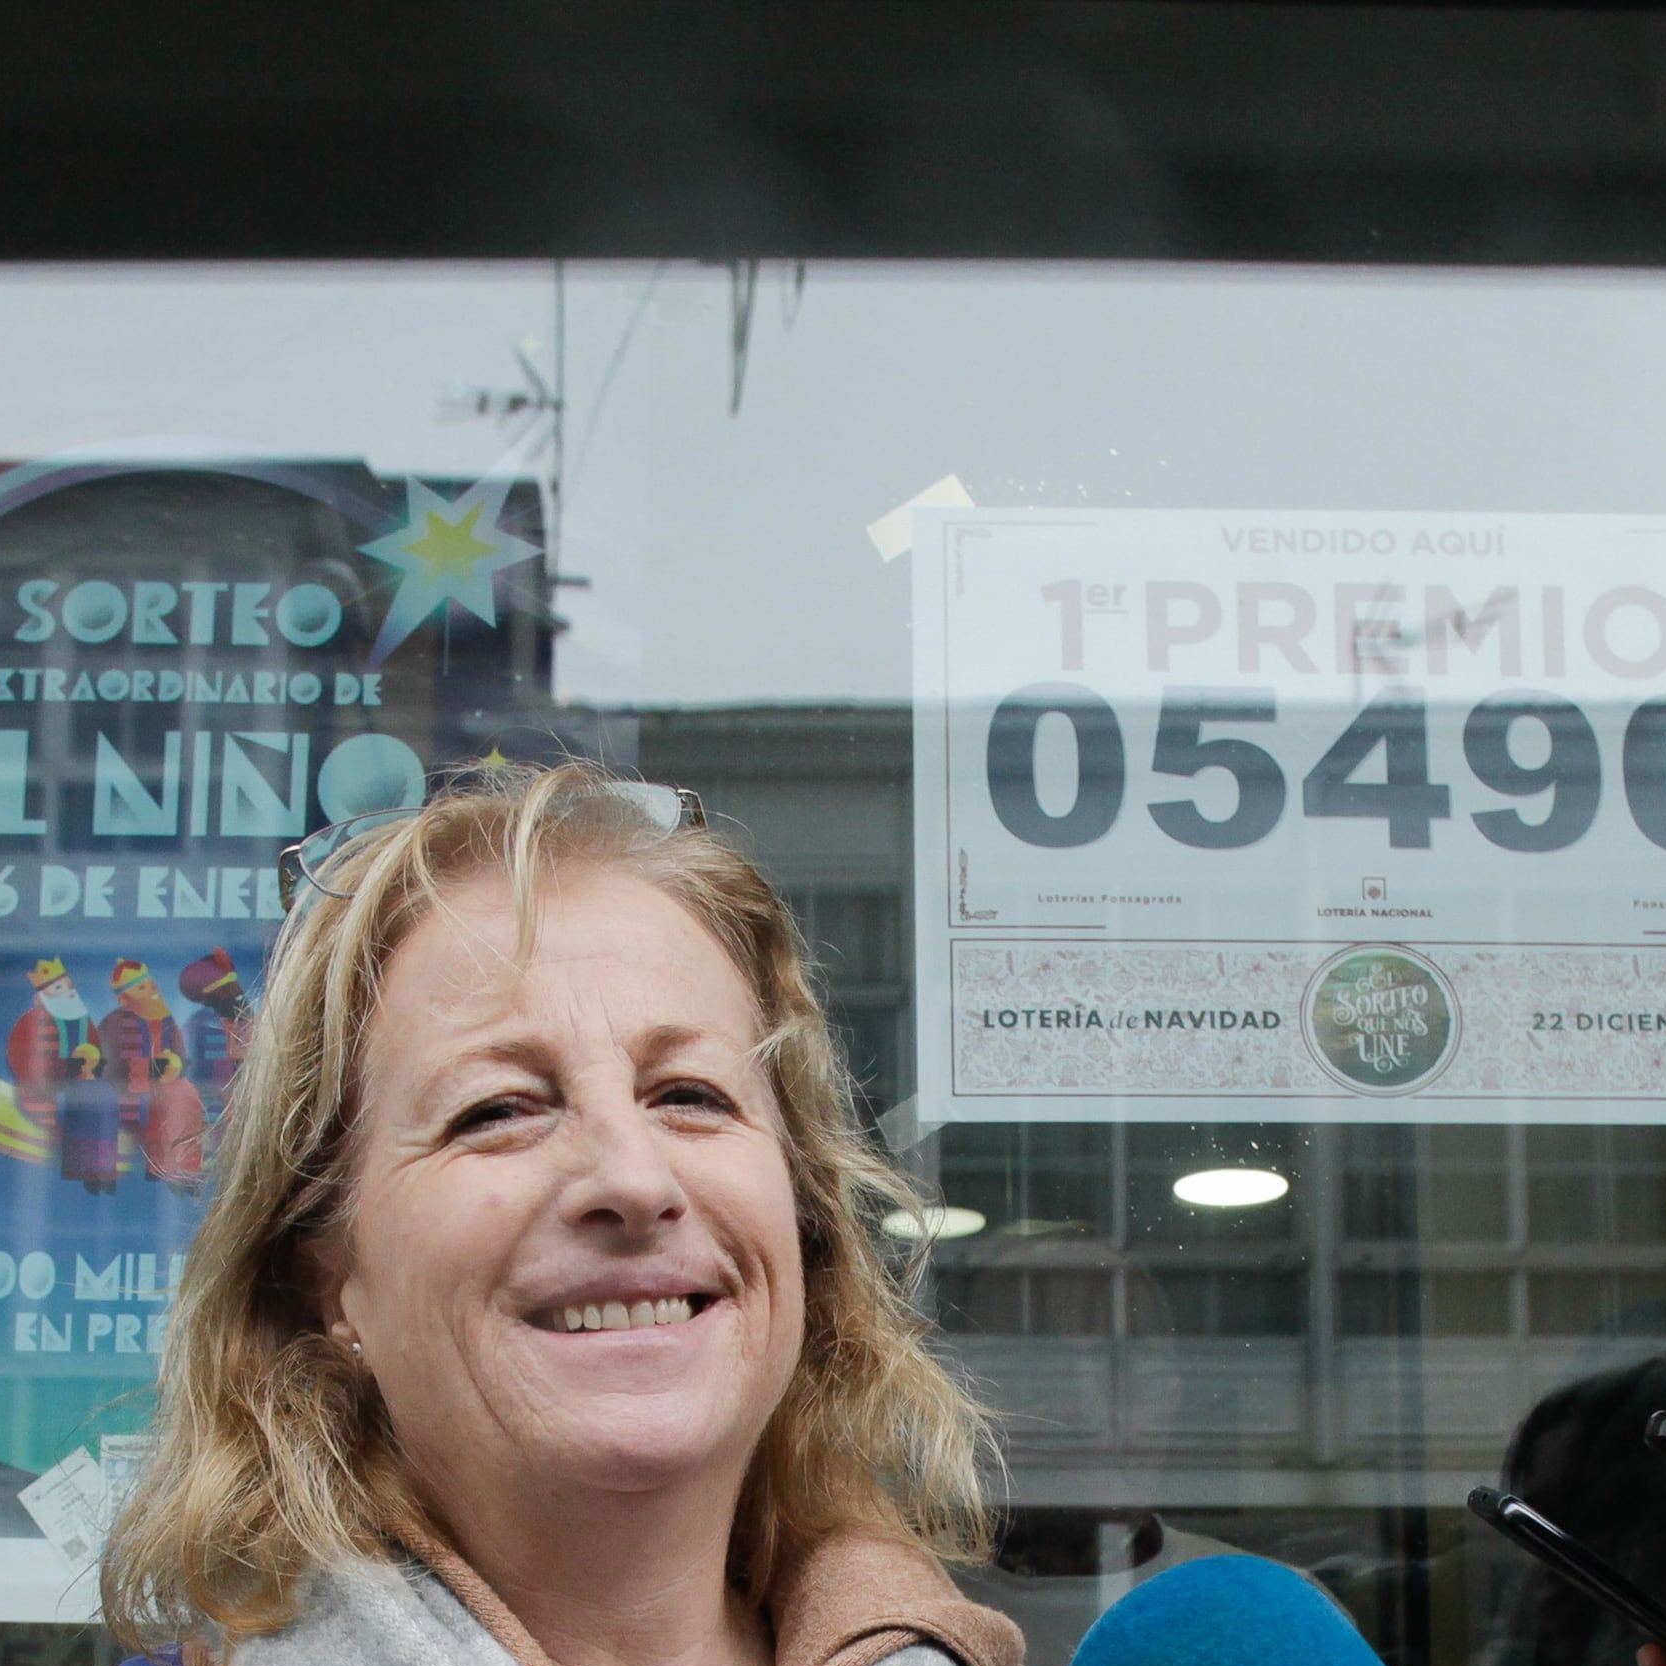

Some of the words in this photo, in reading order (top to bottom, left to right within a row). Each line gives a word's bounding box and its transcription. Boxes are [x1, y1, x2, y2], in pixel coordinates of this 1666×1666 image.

[1221, 525, 1399, 557] VENDIDO
[1409, 520, 1506, 559] AQUÍ
[13, 579, 343, 648] SORTEO
[334, 672, 384, 707] DE
[92, 729, 427, 840] NIÑO
[39, 866, 115, 918] DE
[136, 866, 289, 920] ENER
[1370, 907, 1435, 919] NACIONAL
[983, 1004, 1104, 1030] LOTERÍA
[1109, 1006, 1139, 1031] de
[1143, 1009, 1282, 1031] NAVIDAD
[1333, 983, 1429, 1027] SORTEO
[1357, 1015, 1390, 1034] QUE
[1532, 1011, 1566, 1032] 22
[1349, 1033, 1412, 1073] UNE
[14, 1311, 73, 1353] EN
[87, 1312, 171, 1353] PRE
